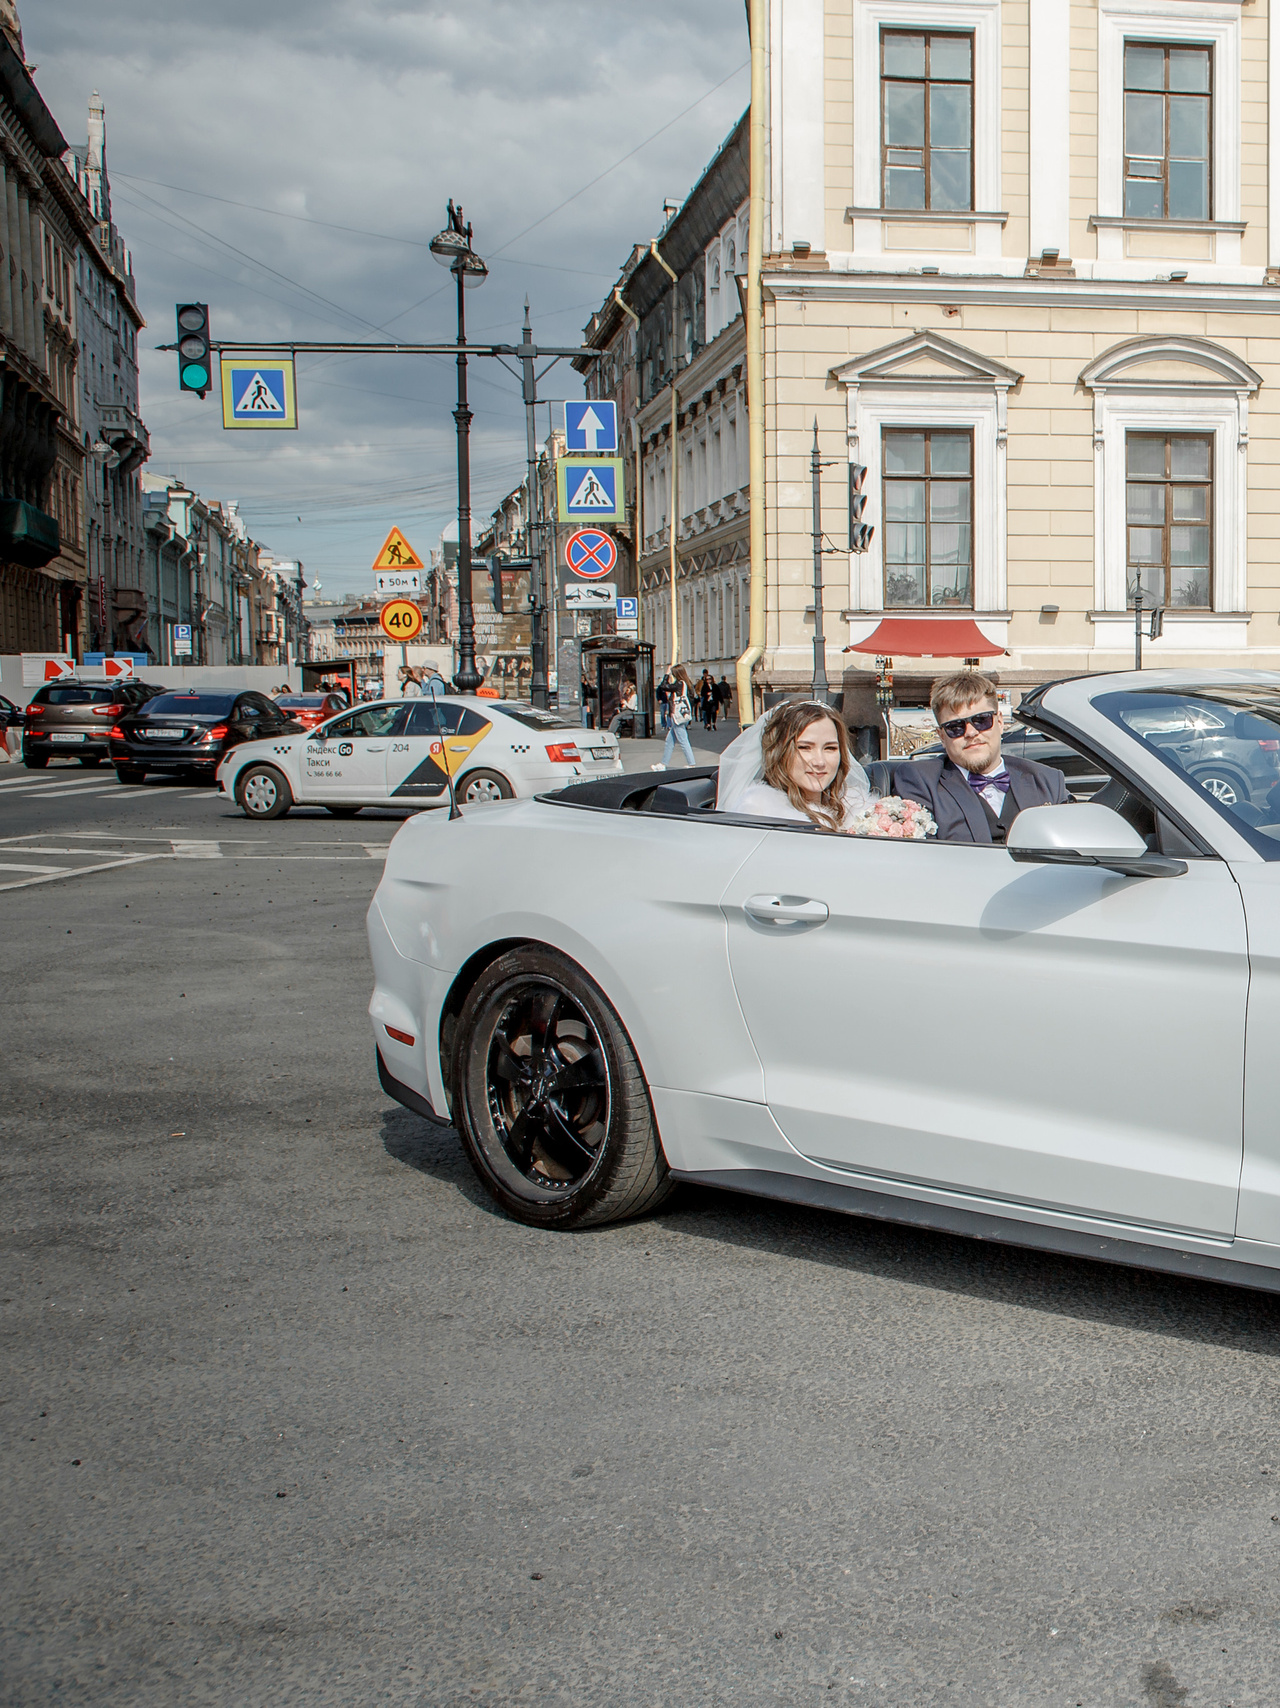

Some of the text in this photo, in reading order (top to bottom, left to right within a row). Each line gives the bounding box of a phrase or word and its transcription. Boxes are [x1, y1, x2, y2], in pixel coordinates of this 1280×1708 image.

[389, 612, 413, 628] 40
[306, 743, 352, 755] Яндекс Go
[392, 743, 410, 753] 204
[432, 743, 440, 753] Я
[307, 757, 331, 767] Такси
